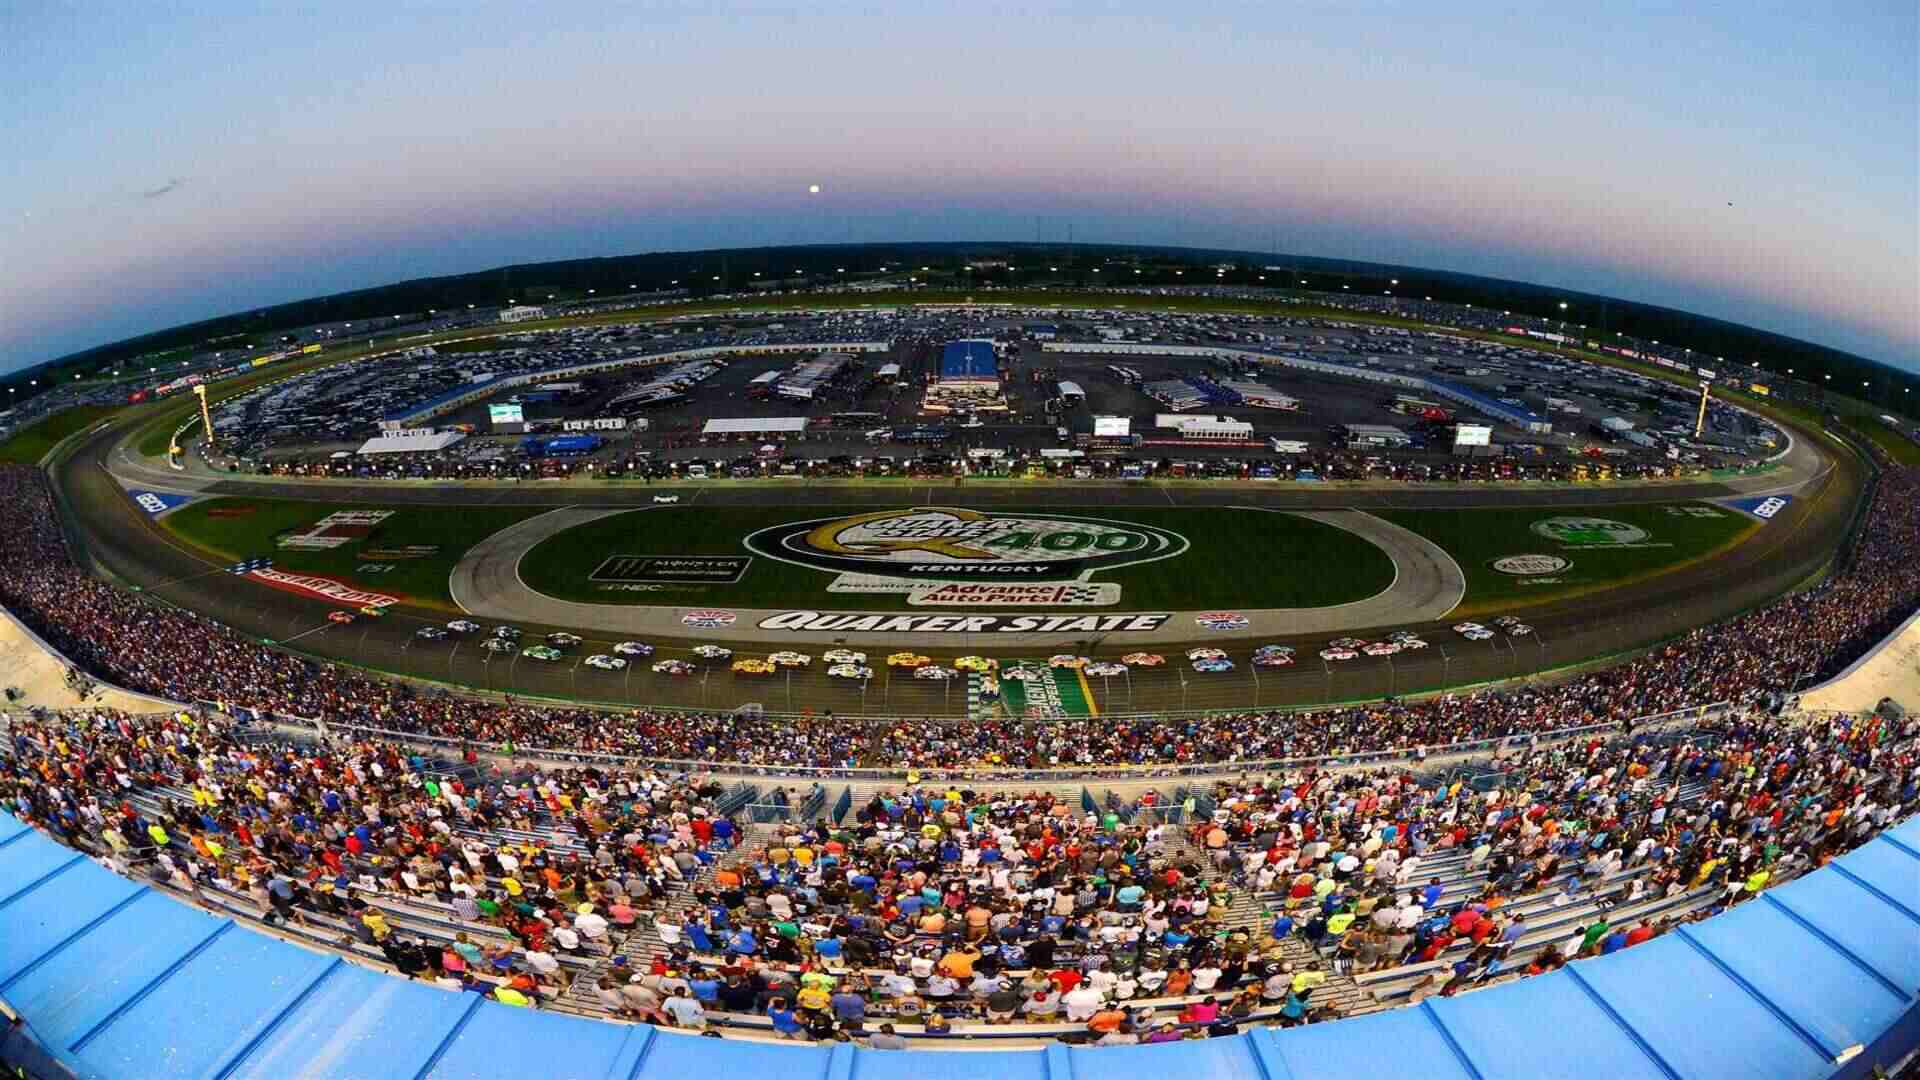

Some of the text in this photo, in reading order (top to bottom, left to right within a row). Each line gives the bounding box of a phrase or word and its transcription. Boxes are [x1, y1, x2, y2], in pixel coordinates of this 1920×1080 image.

[864, 519, 1021, 530] QUAKER
[876, 528, 989, 538] STATE
[983, 531, 1142, 551] 400
[908, 564, 1049, 573] KENTUCKY
[936, 582, 1056, 594] Advance
[920, 593, 1053, 603] Auto Parts
[758, 611, 998, 632] QUAKER
[997, 614, 1170, 633] STATE
